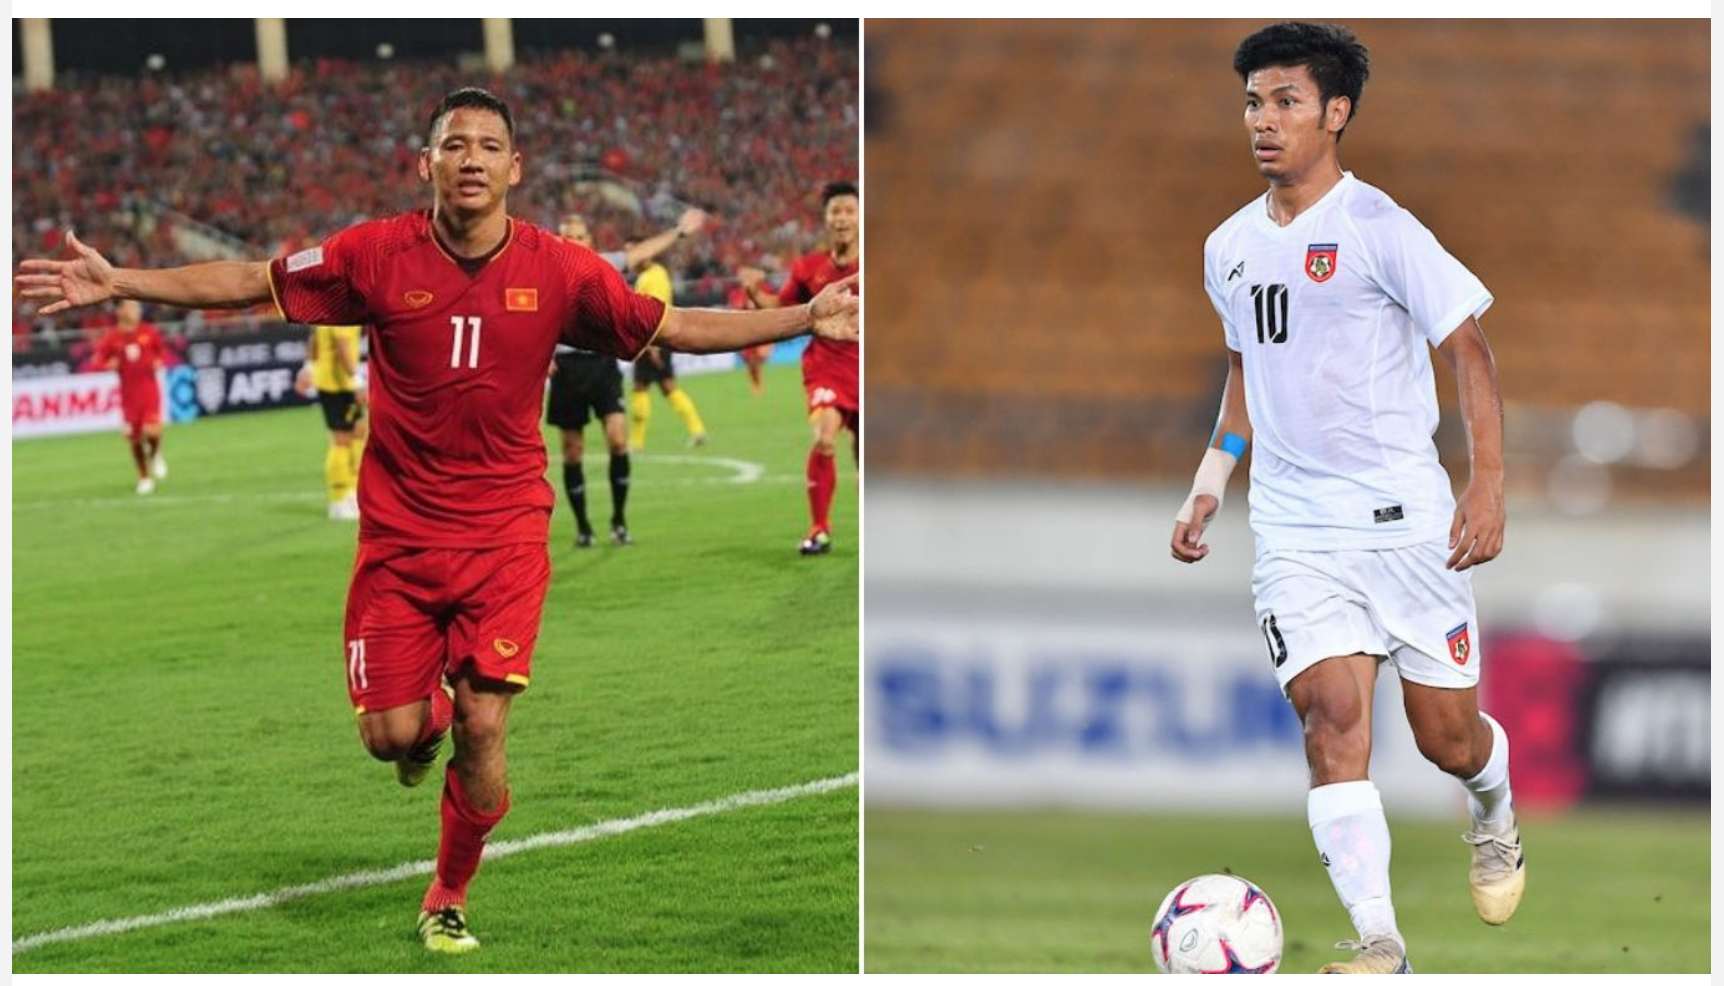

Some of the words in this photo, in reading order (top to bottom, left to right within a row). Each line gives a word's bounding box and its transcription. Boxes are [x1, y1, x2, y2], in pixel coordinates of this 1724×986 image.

[1250, 284, 1289, 344] 10
[450, 315, 482, 369] 11
[12, 388, 122, 422] ANMA
[228, 368, 292, 405] AFF
[348, 638, 368, 690] 11
[1261, 613, 1288, 668] 0
